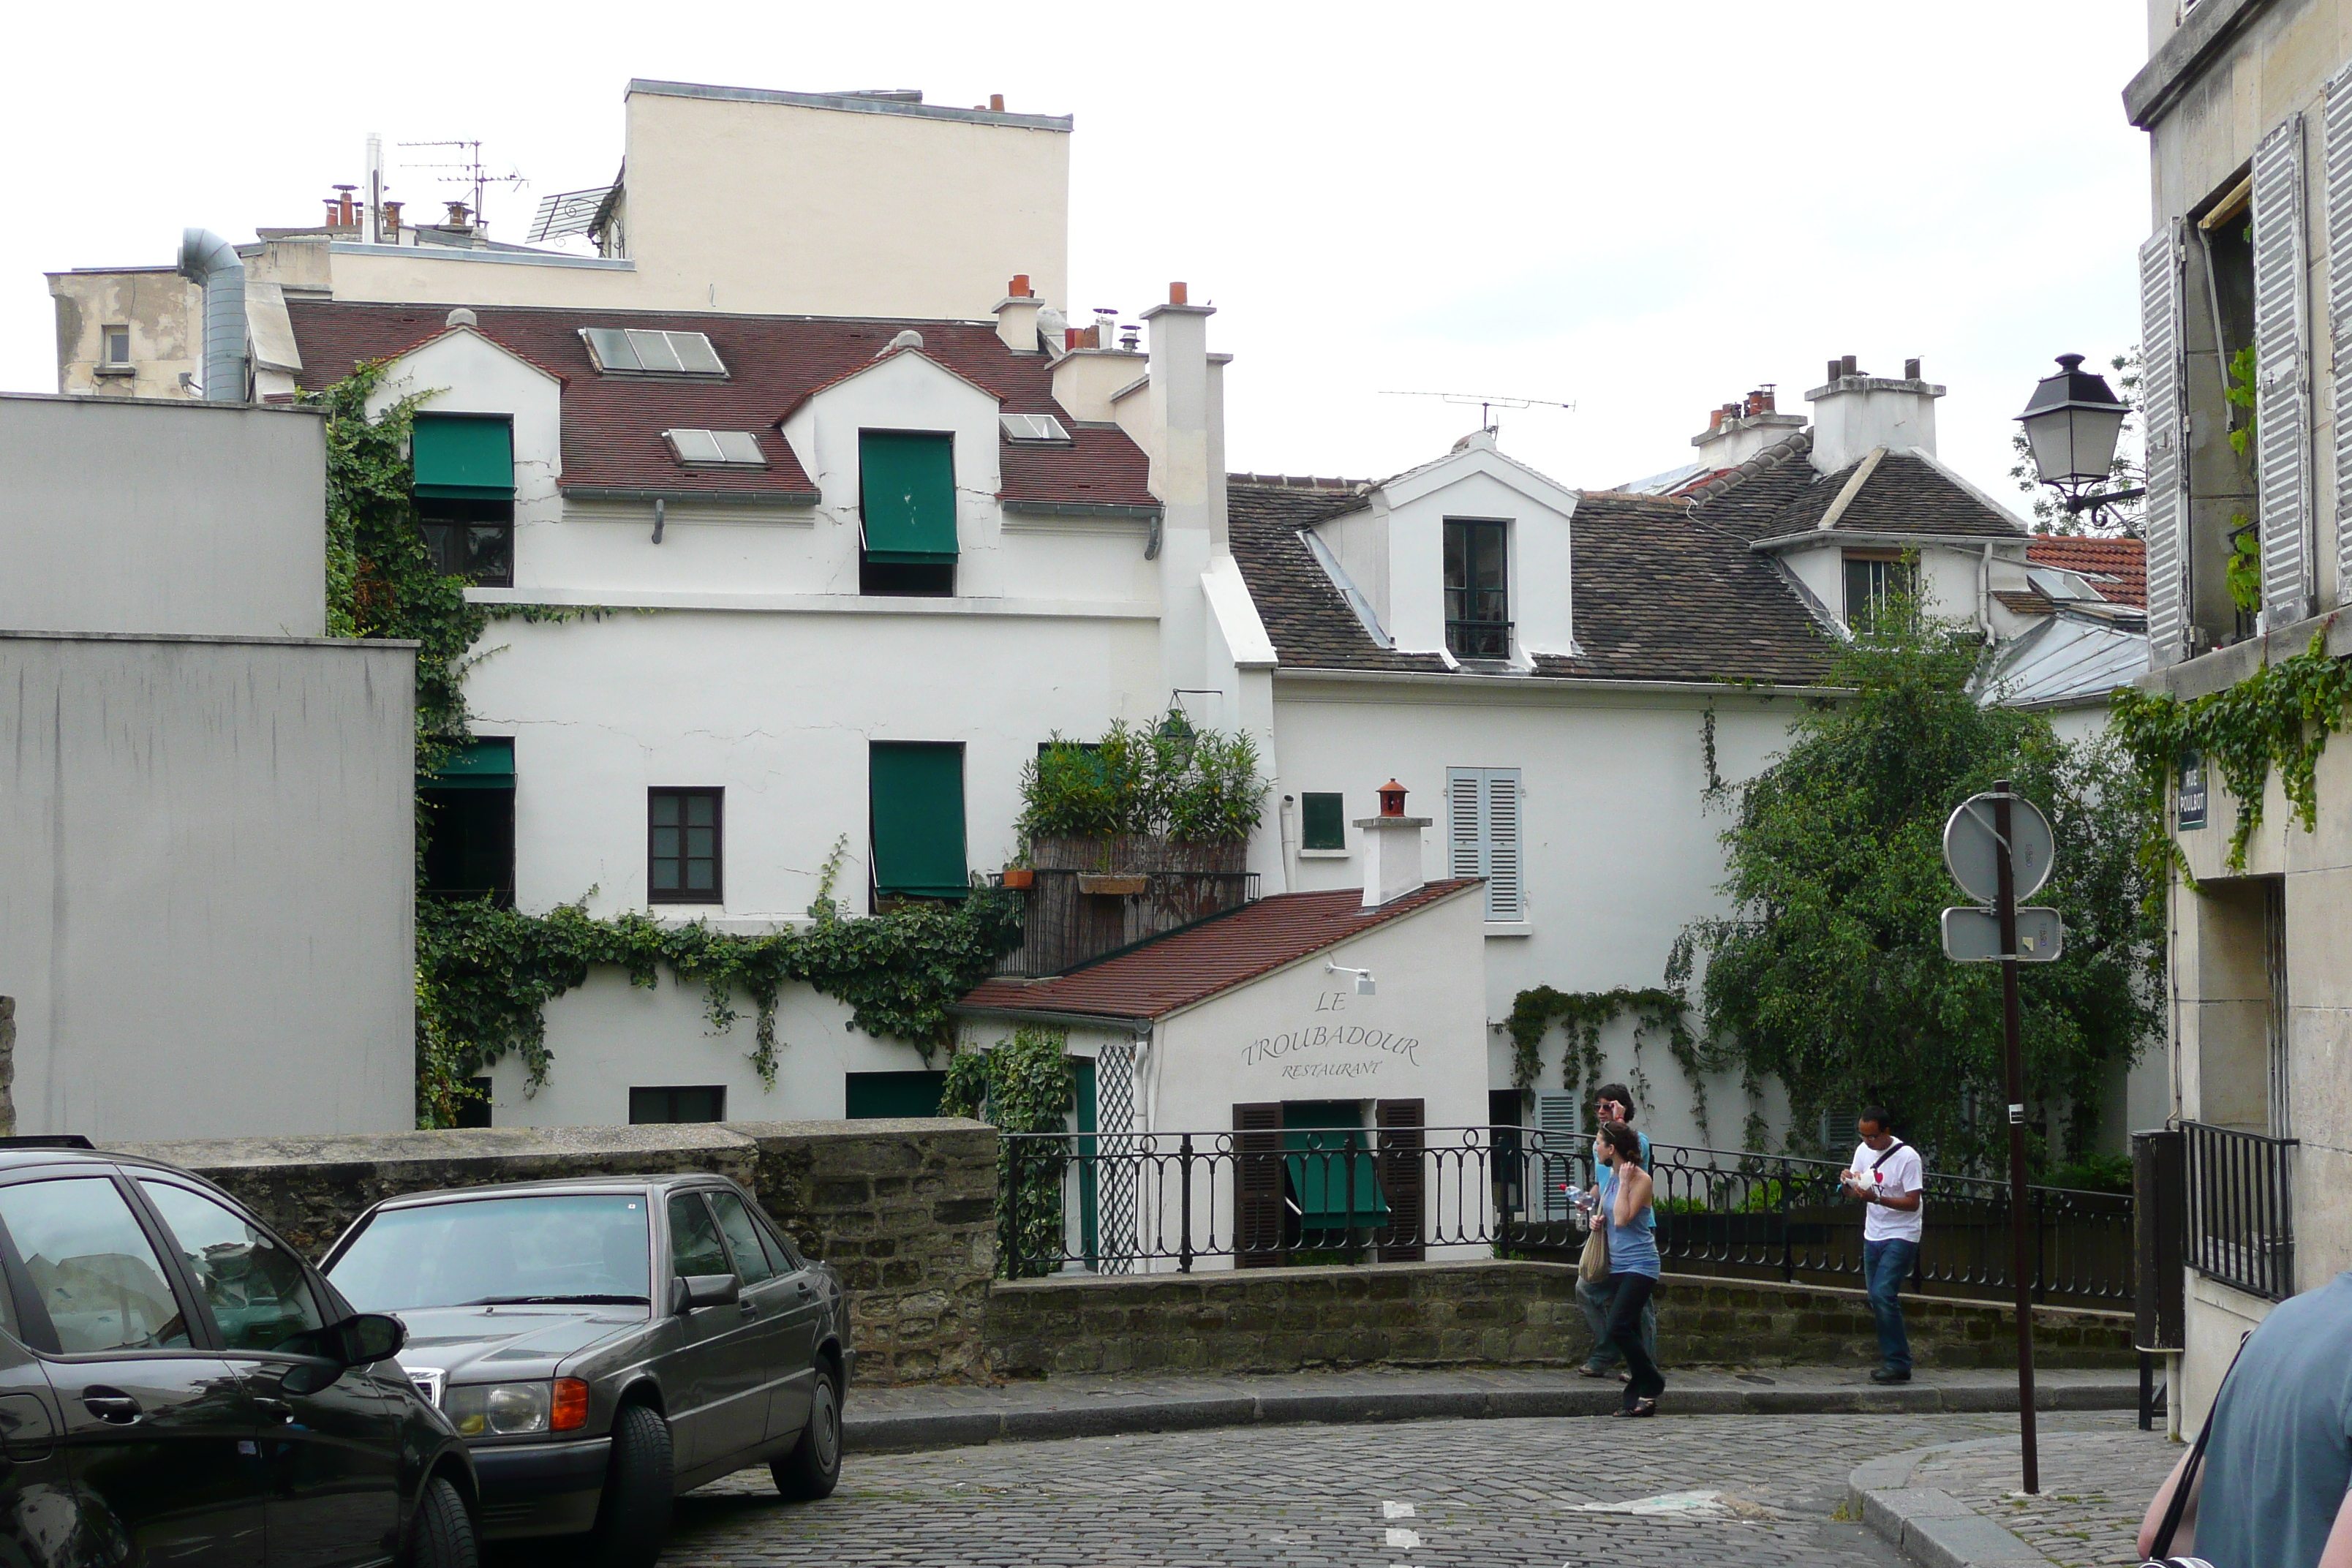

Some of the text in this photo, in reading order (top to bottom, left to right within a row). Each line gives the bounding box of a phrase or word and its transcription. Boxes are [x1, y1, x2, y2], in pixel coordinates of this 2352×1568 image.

[2186, 769, 2198, 787] RUE
[2179, 792, 2204, 813] POULBOT
[1315, 991, 1346, 1012] LE
[1242, 1025, 1420, 1067] TROUBADOUR
[1281, 1060, 1383, 1079] RESTAURANT
